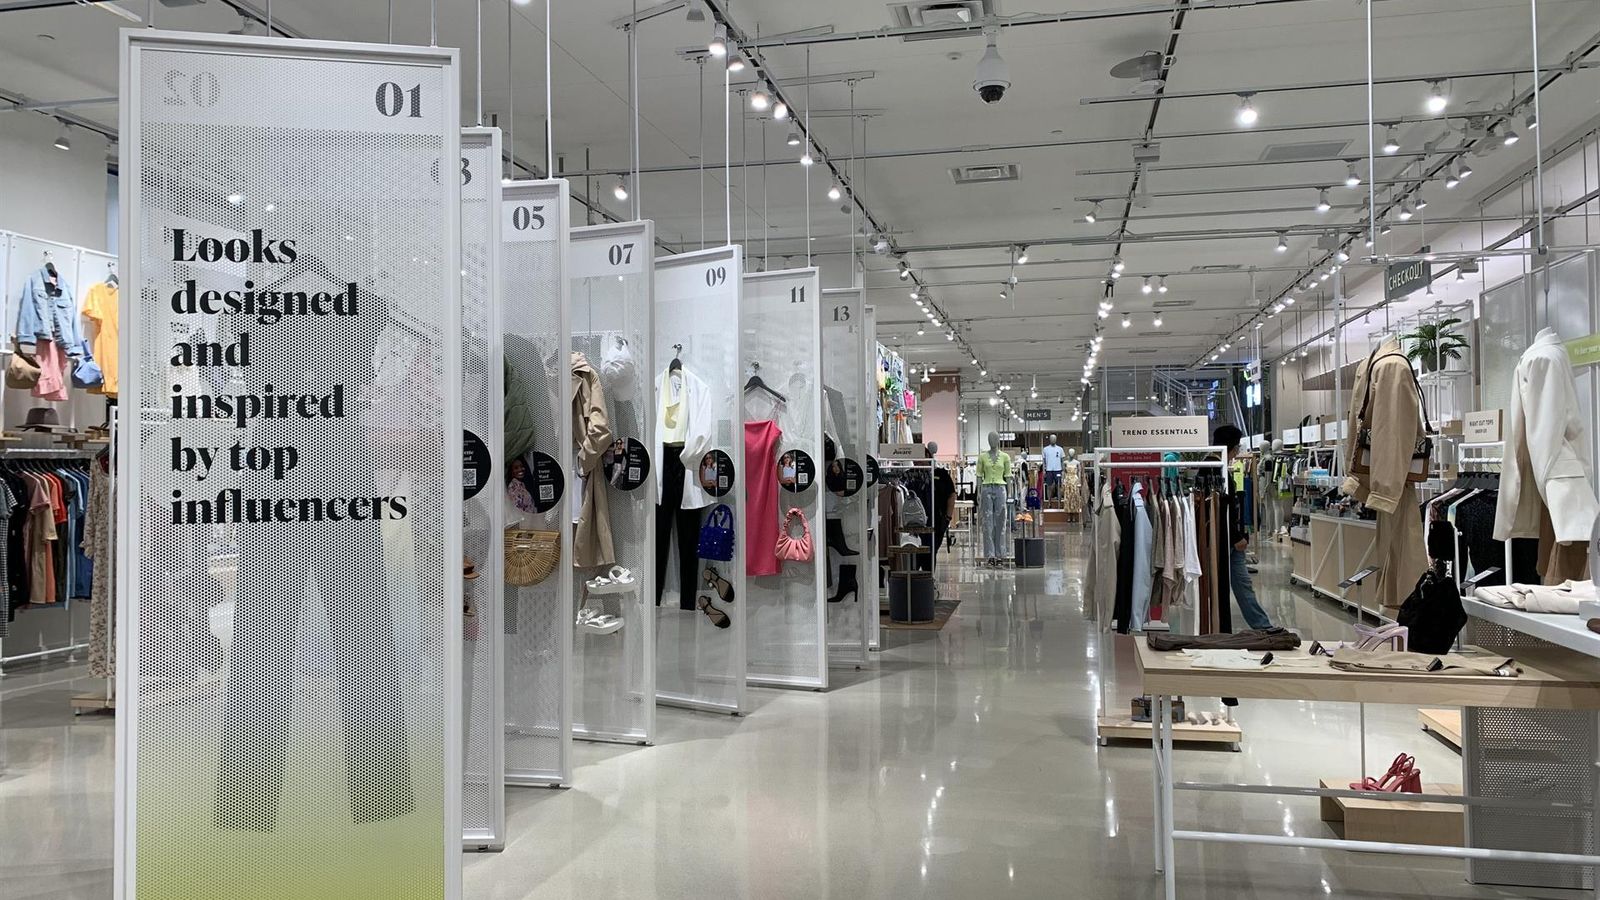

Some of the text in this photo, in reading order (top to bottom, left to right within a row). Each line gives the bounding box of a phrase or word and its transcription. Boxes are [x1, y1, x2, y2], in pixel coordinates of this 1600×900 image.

[375, 81, 424, 118] 01
[512, 205, 545, 231] 05
[172, 228, 298, 264] Looks
[608, 243, 635, 266] 07
[706, 266, 726, 287] 09
[1388, 260, 1425, 290] CHECKOUT
[170, 280, 359, 326] designed
[791, 286, 805, 303] 11
[833, 305, 850, 321] 13
[170, 332, 251, 368] and
[171, 384, 344, 429] inspired
[171, 436, 299, 481] by top
[171, 488, 408, 525] influencers
